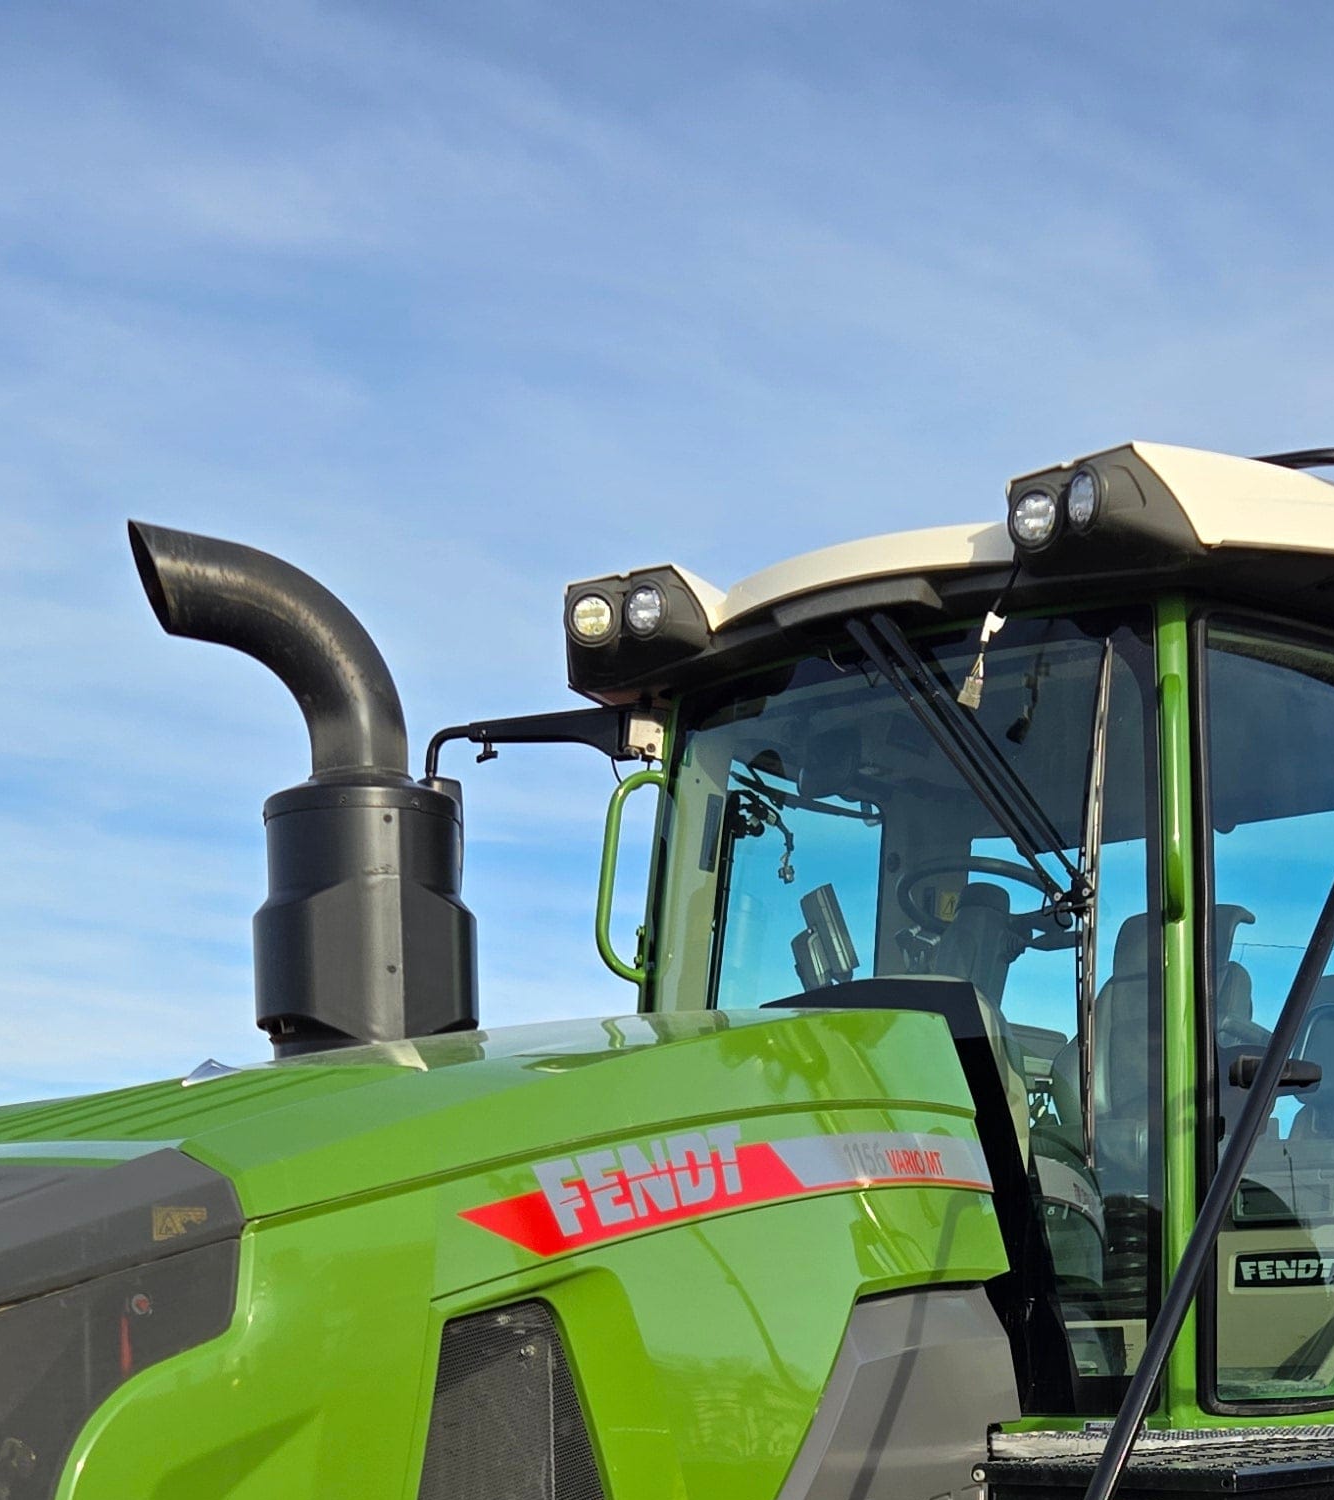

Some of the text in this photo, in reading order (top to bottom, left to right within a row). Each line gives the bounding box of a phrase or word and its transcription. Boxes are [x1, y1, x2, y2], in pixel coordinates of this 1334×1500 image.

[533, 1126, 742, 1237] FENDT
[843, 1142, 944, 1176] 1156 VARIO MT
